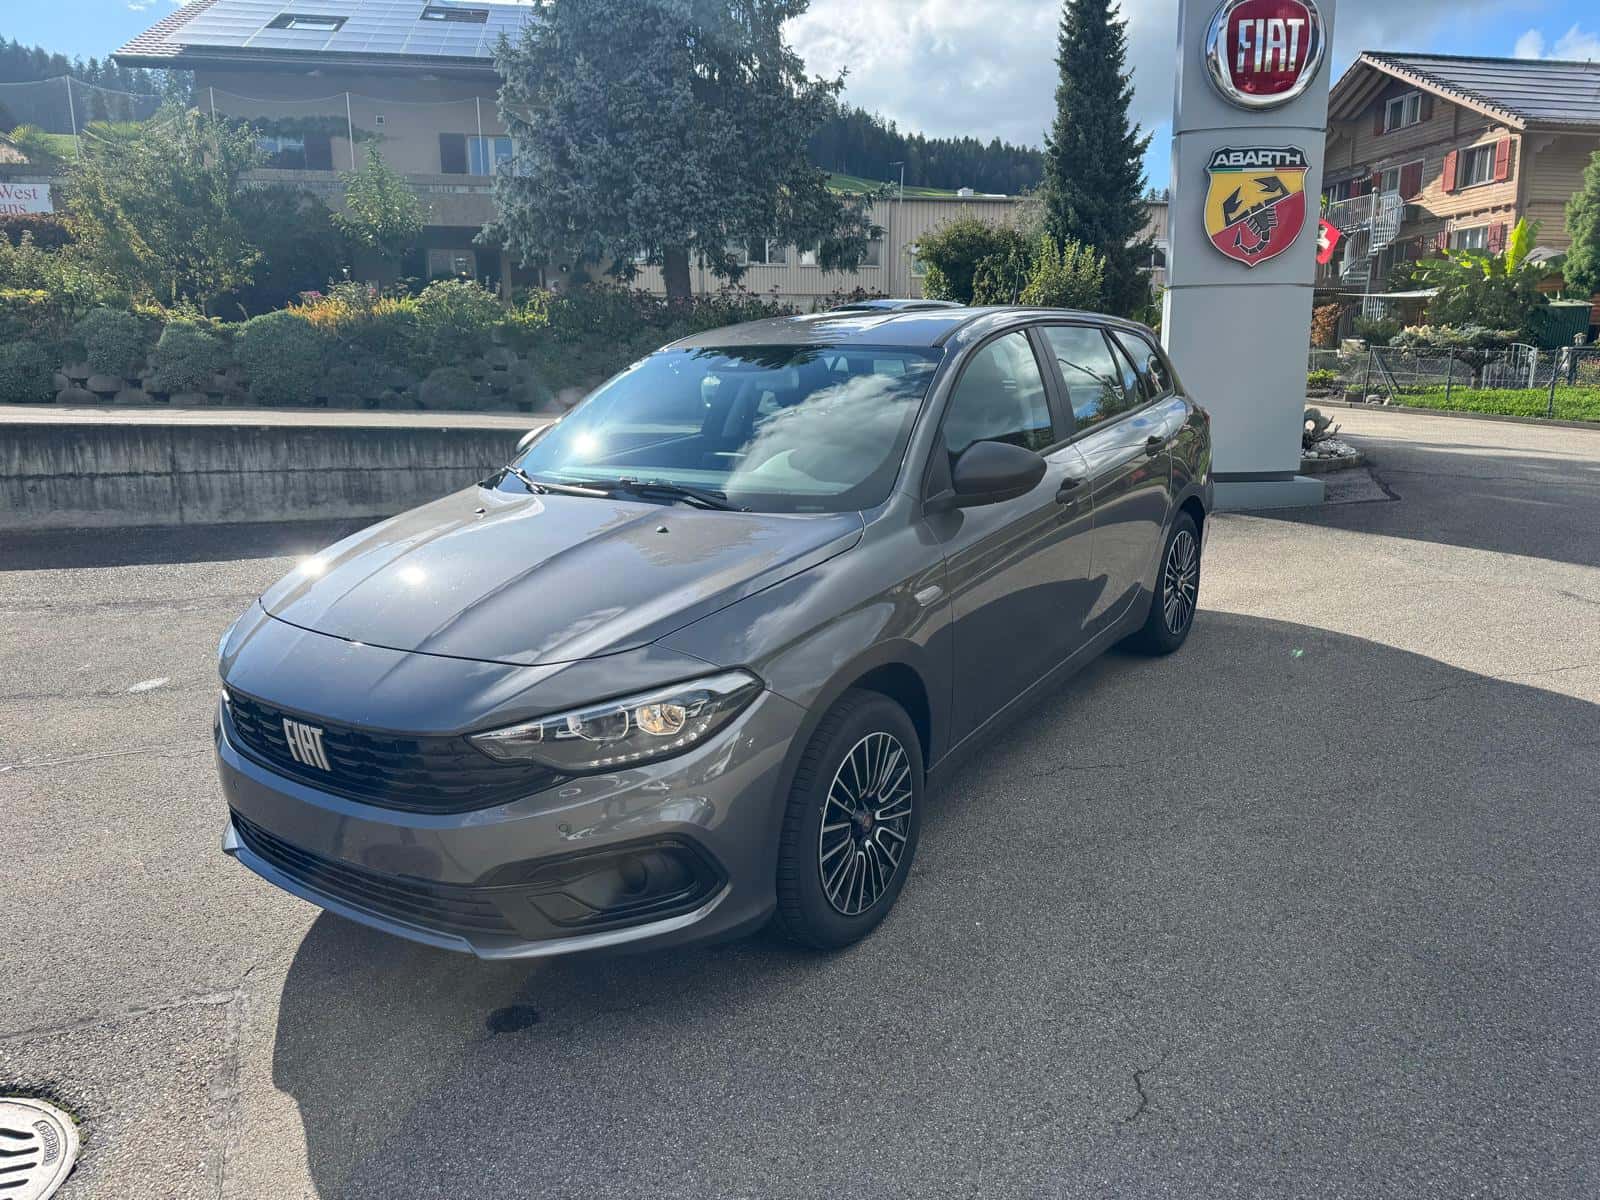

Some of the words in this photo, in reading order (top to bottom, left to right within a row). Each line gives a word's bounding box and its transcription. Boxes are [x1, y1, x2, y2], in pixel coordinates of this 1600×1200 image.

[1236, 18, 1305, 73] FIAT
[1213, 151, 1301, 166] ABARTH
[282, 718, 332, 772] FIAT
